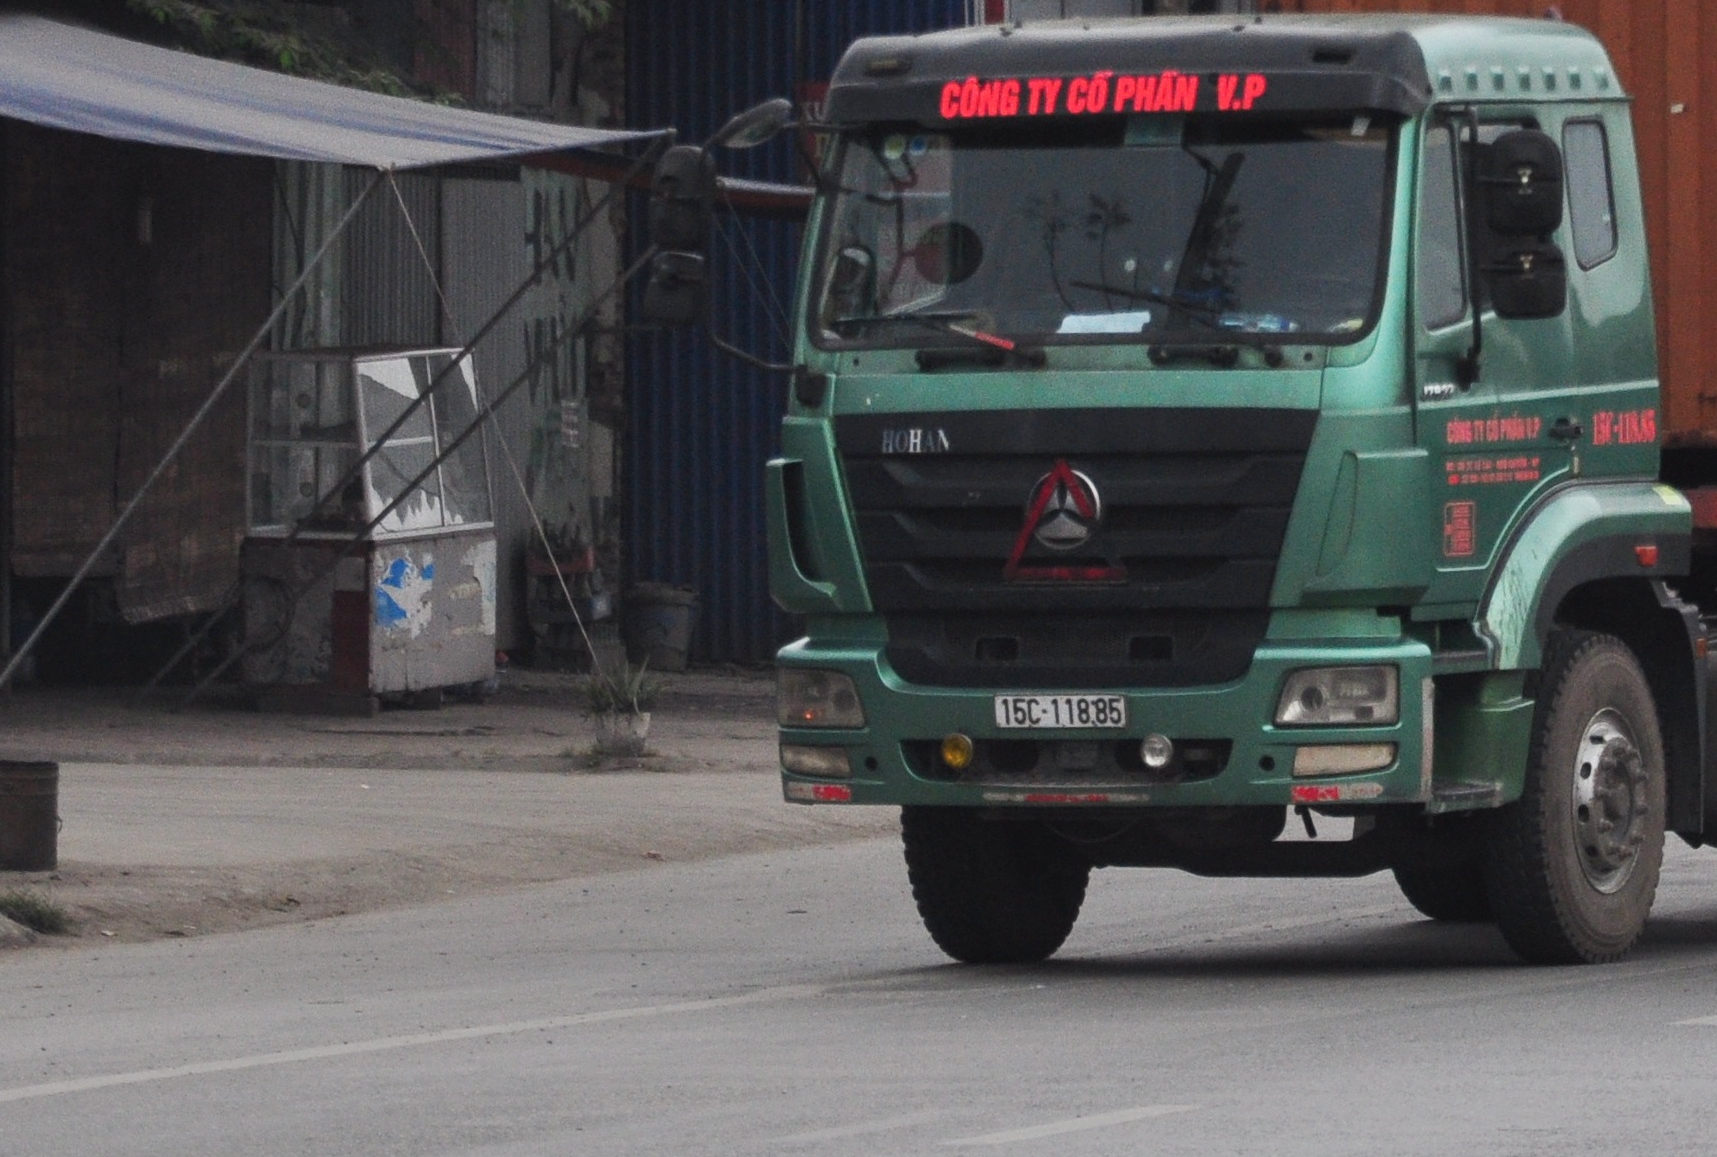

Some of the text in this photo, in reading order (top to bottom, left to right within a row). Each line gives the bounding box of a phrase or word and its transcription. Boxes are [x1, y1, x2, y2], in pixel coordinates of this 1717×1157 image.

[939, 75, 1021, 119] CÔNG
[1027, 77, 1062, 116] TY
[1217, 73, 1268, 111] V.P
[882, 428, 949, 453] HOHAN
